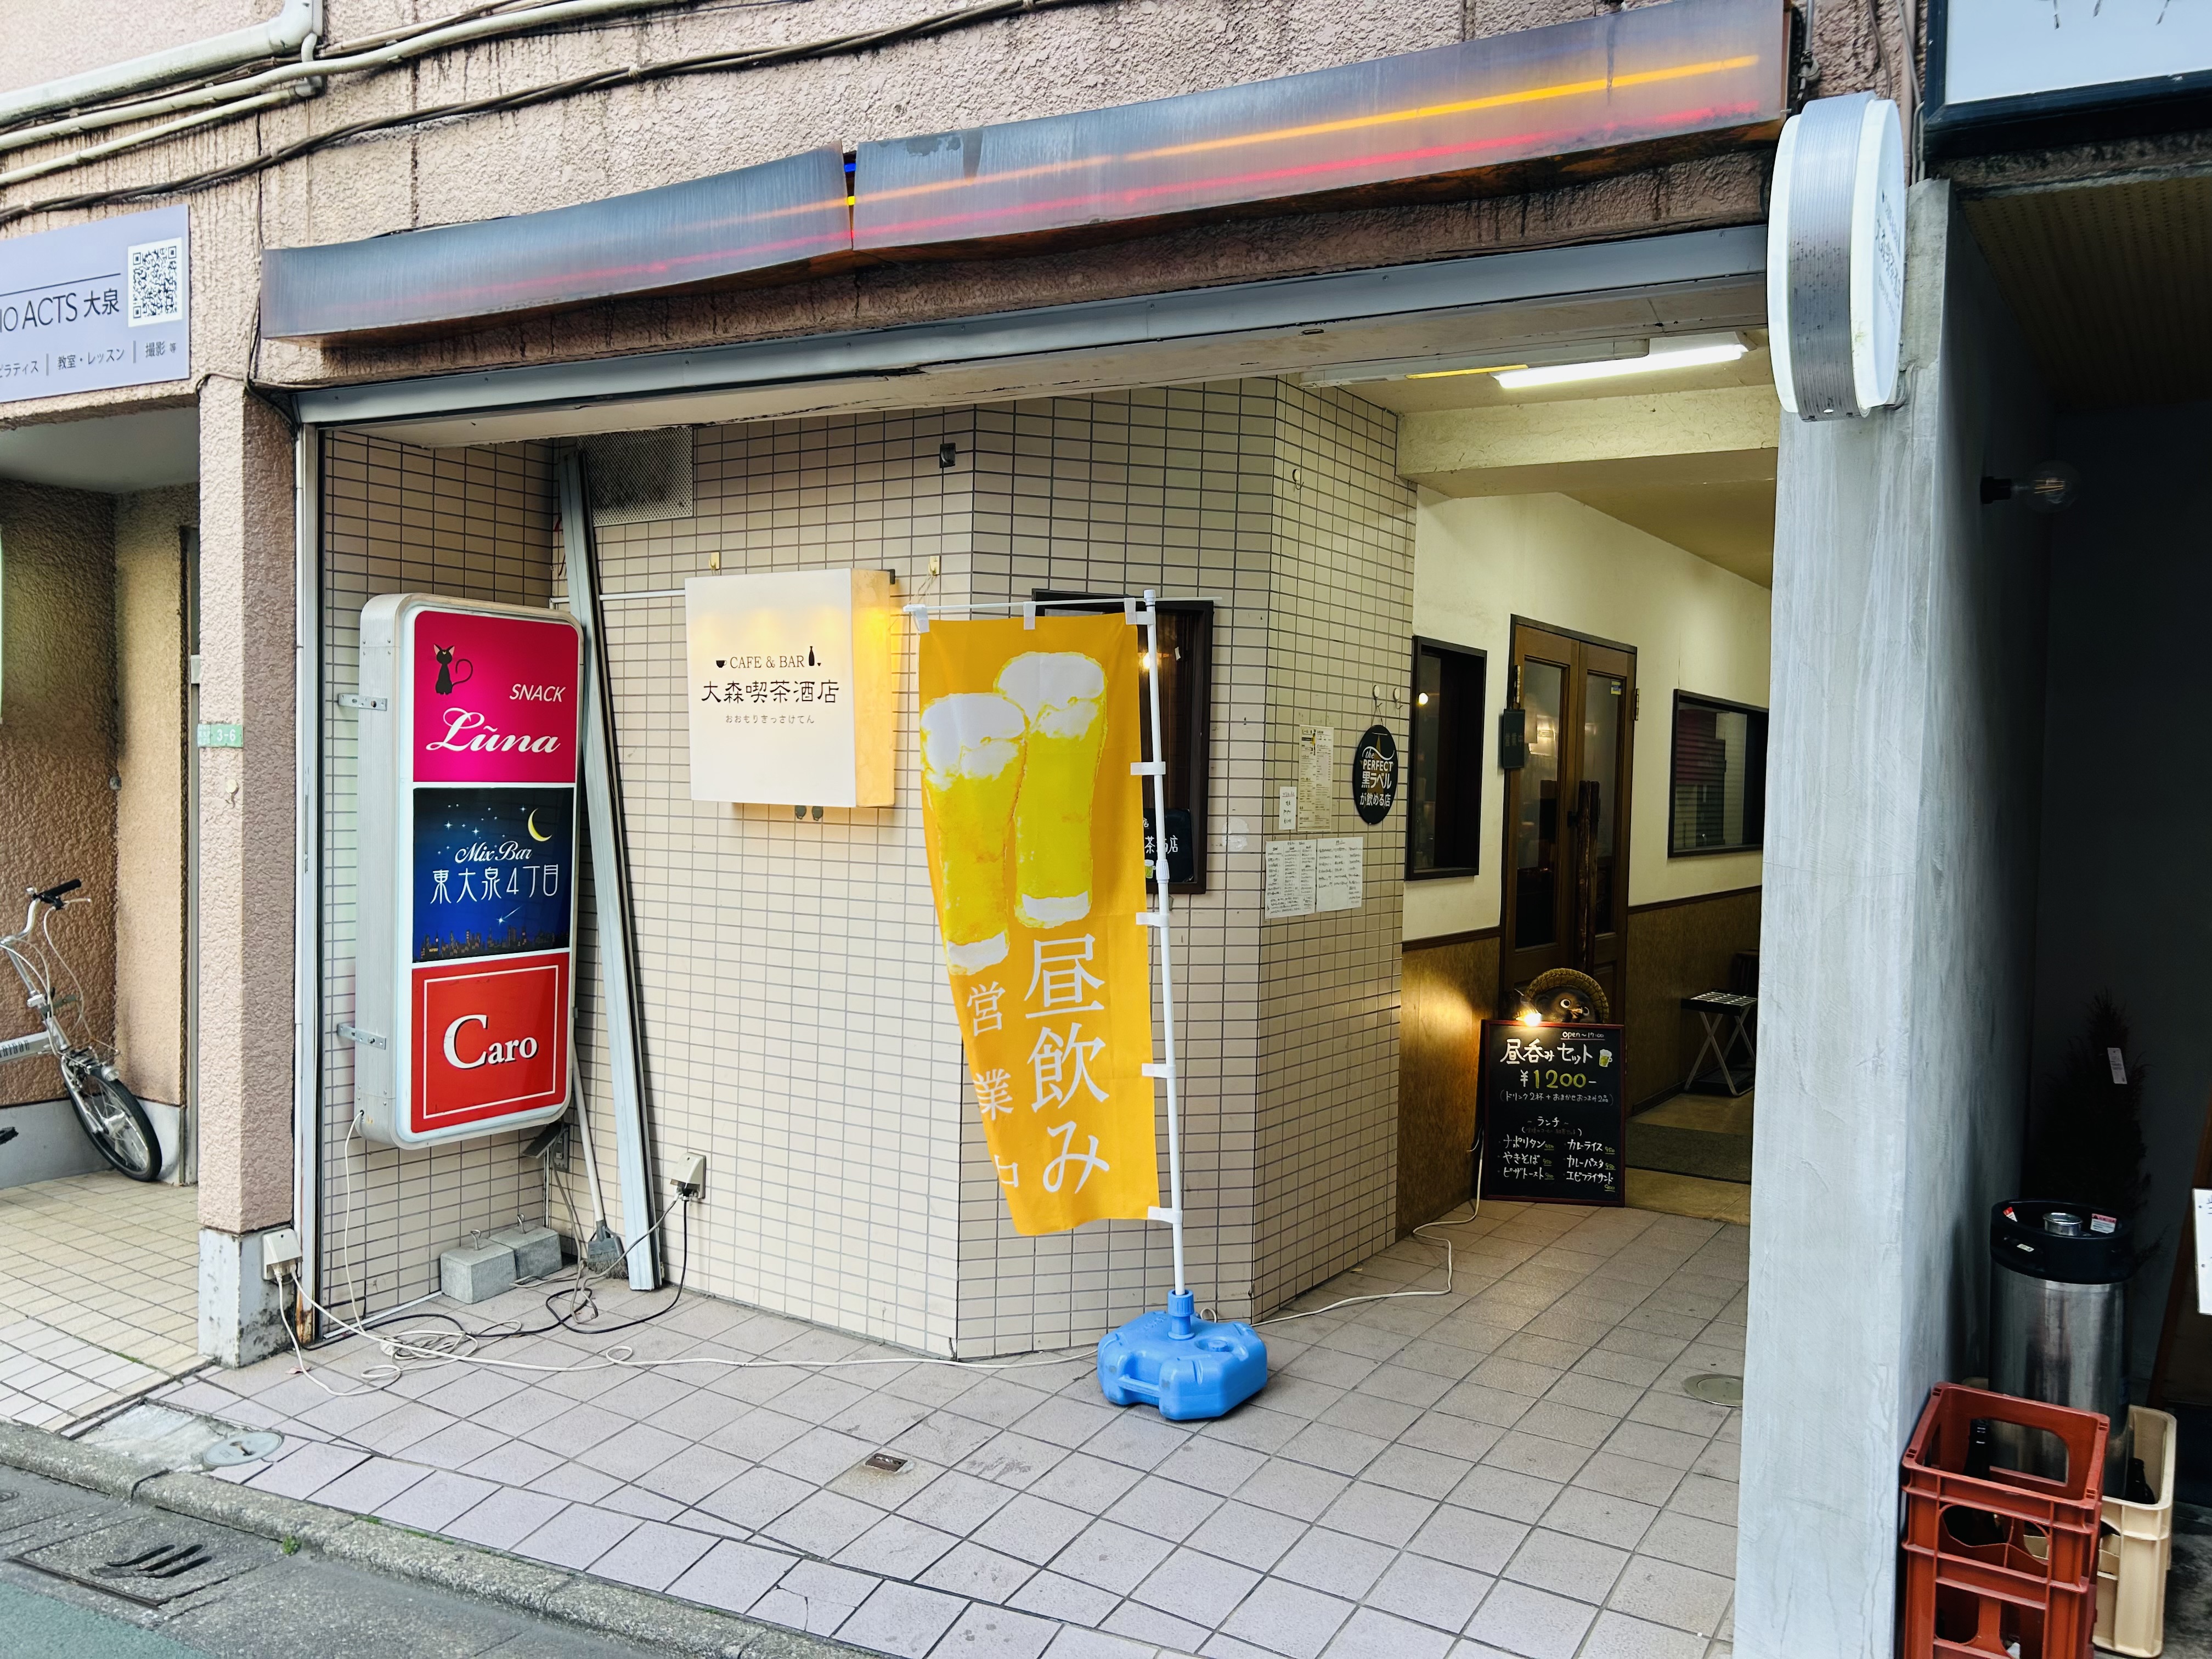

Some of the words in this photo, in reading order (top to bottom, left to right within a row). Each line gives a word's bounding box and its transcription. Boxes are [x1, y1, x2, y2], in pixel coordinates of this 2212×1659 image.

[22, 292, 77, 329] ACTS
[83, 287, 120, 318] 大泉
[57, 349, 125, 370] 教室・レッスン
[730, 656, 762, 669] CAFE
[766, 656, 776, 668] &
[779, 655, 805, 668] BAR
[509, 683, 566, 703] SNACK
[701, 679, 839, 704] 大森喫茶酒店
[725, 714, 815, 724] おおもりきっさけてん
[217, 729, 236, 742] 3-6
[1365, 748, 1375, 759] the
[1363, 759, 1393, 772] PERFECT
[1361, 771, 1392, 789] 黒ラベル
[1359, 792, 1391, 807] が飲める店
[455, 841, 495, 864] Mix
[495, 840, 533, 861] Bar
[430, 864, 559, 905] 東大泉4丁目
[443, 1014, 539, 1069] Caro
[1500, 1038, 1593, 1065] 昼呑みセット
[1024, 933, 1110, 1194] 昼飲み
[1503, 1133, 1545, 1149] ナポリタン
[1567, 1138, 1603, 1152] カレーライス
[1503, 1152, 1541, 1165] やきそば
[1567, 1154, 1604, 1169] カレーパスタ
[1503, 1166, 1544, 1180] ピザトースト
